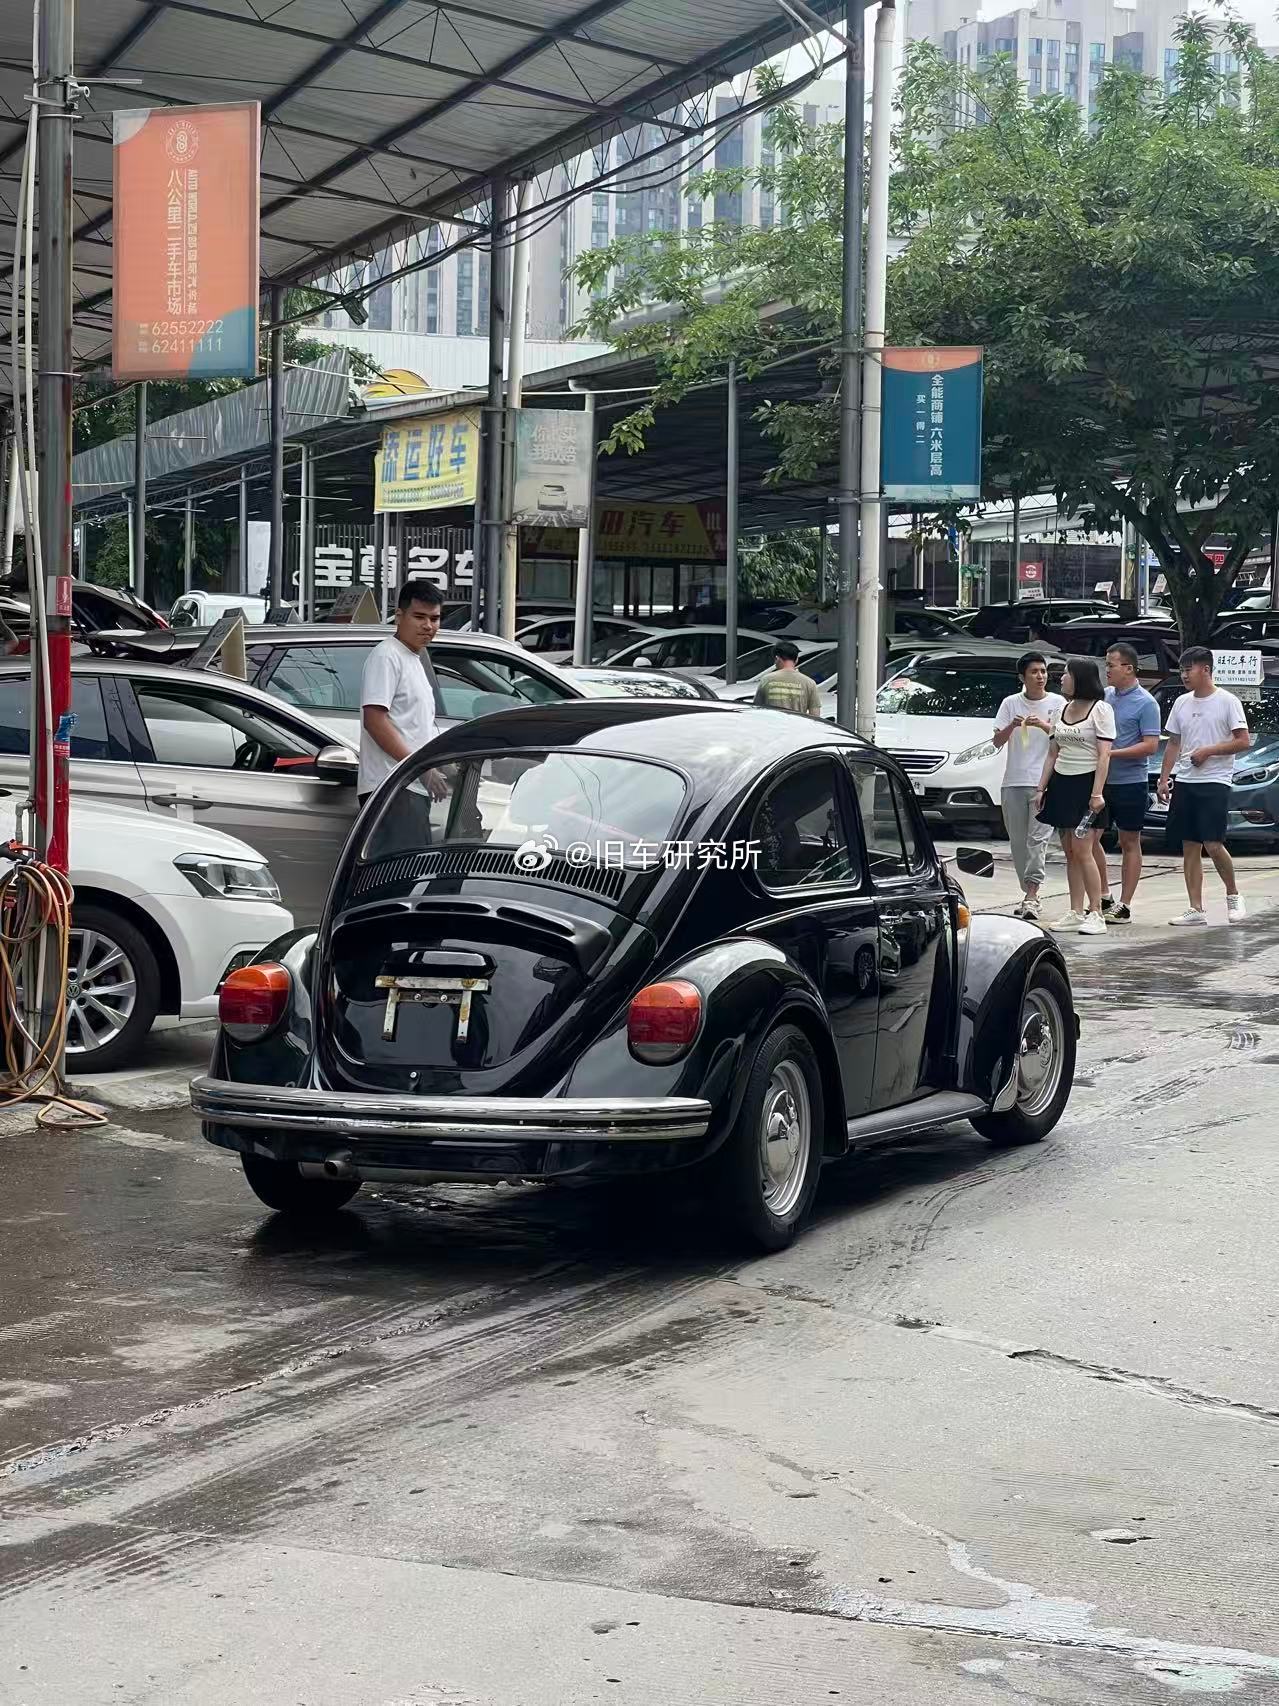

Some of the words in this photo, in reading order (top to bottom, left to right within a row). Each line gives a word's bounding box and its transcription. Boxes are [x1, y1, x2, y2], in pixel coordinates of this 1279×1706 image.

[167, 169, 182, 315] 八公里二手车市场
[152, 319, 224, 336] 62552222
[152, 337, 222, 353] 62411111
[915, 394, 926, 444] 买一得二
[930, 374, 944, 424] 全能商铺
[930, 427, 944, 477] 六米层高
[1217, 655, 1258, 669] 旺记车行
